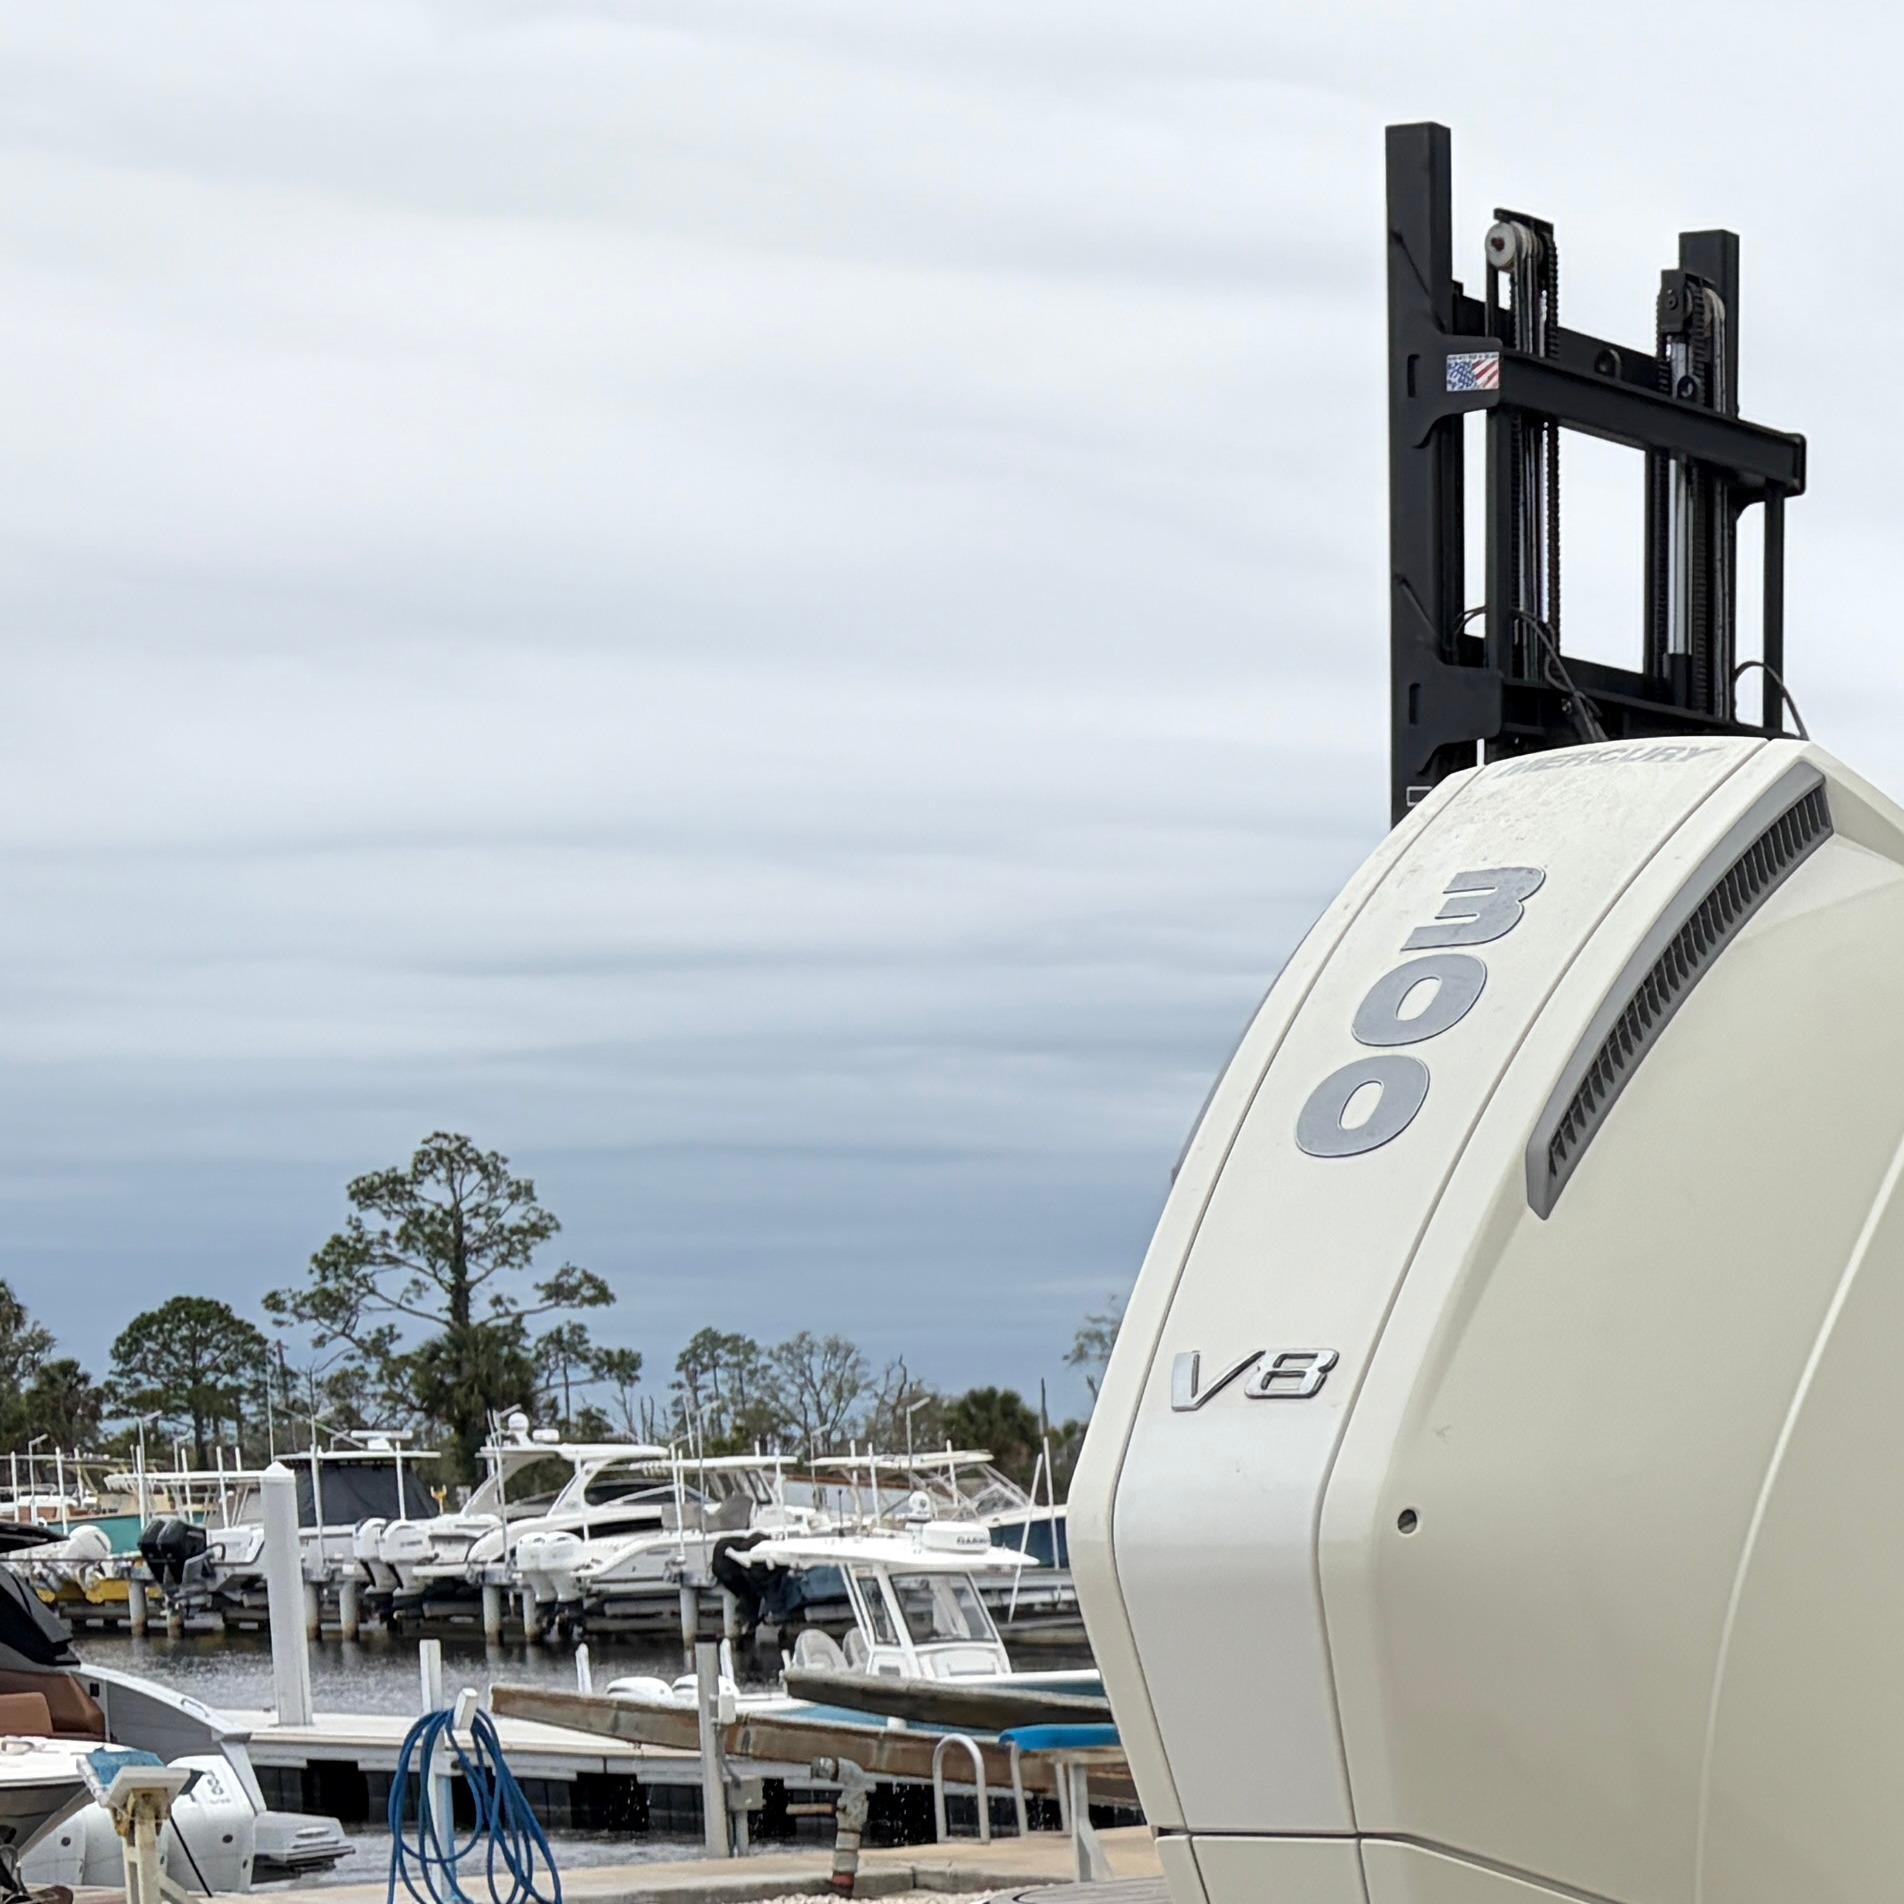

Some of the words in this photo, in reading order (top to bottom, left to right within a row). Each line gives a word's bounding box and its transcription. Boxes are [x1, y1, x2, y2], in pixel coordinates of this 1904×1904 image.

[1493, 745, 1726, 779] MERCURY
[1296, 866, 1546, 1158] 300
[1171, 1348, 1340, 1412] V8
